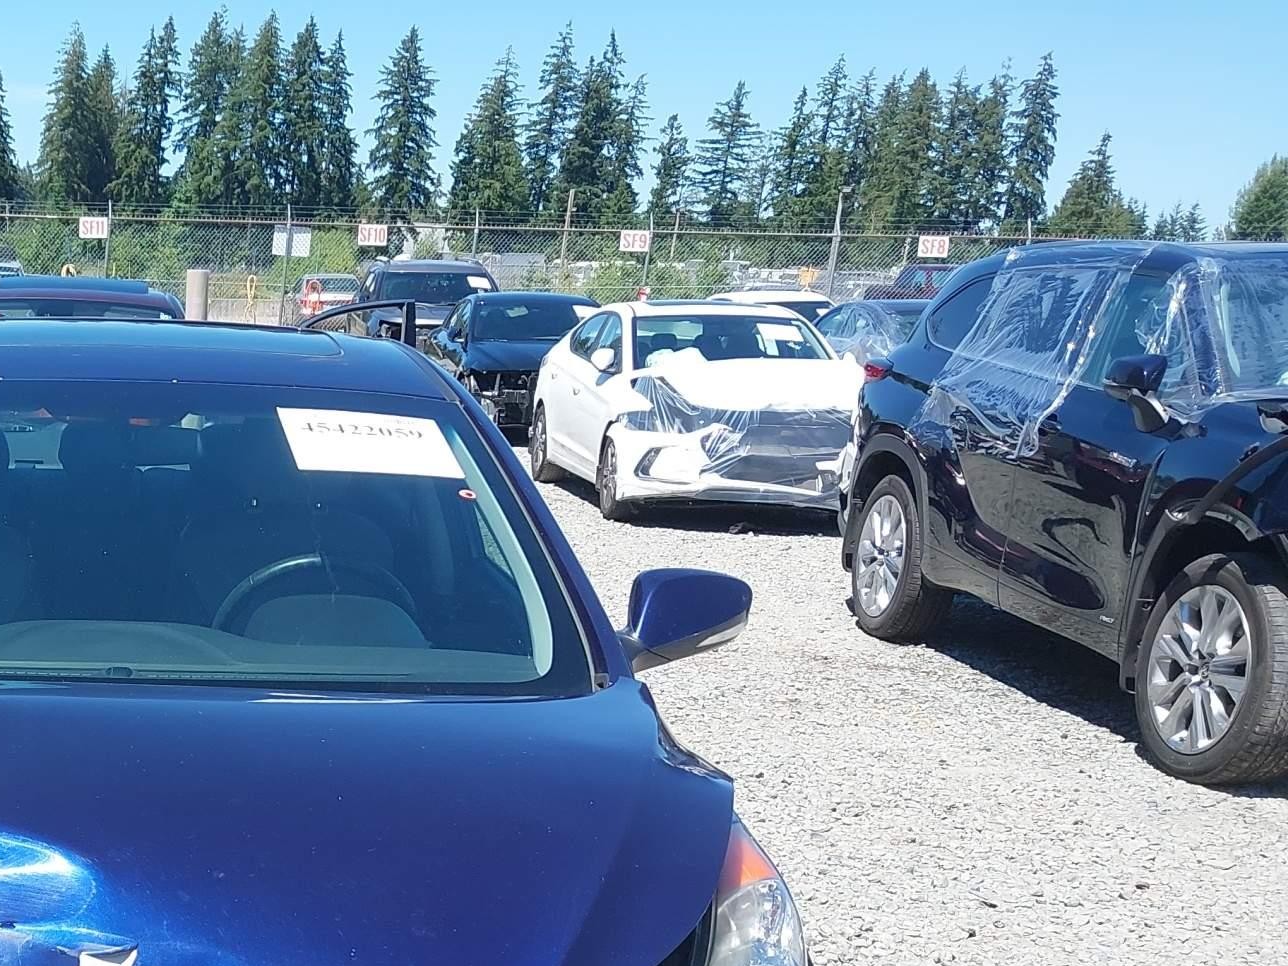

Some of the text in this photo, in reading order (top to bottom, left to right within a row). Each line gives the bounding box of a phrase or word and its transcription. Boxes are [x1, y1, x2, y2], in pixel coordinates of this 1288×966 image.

[82, 220, 105, 235] SF11
[360, 226, 386, 243] SF10
[622, 233, 648, 249] SF9
[921, 238, 946, 255] SF8
[300, 421, 424, 440] 45422059
